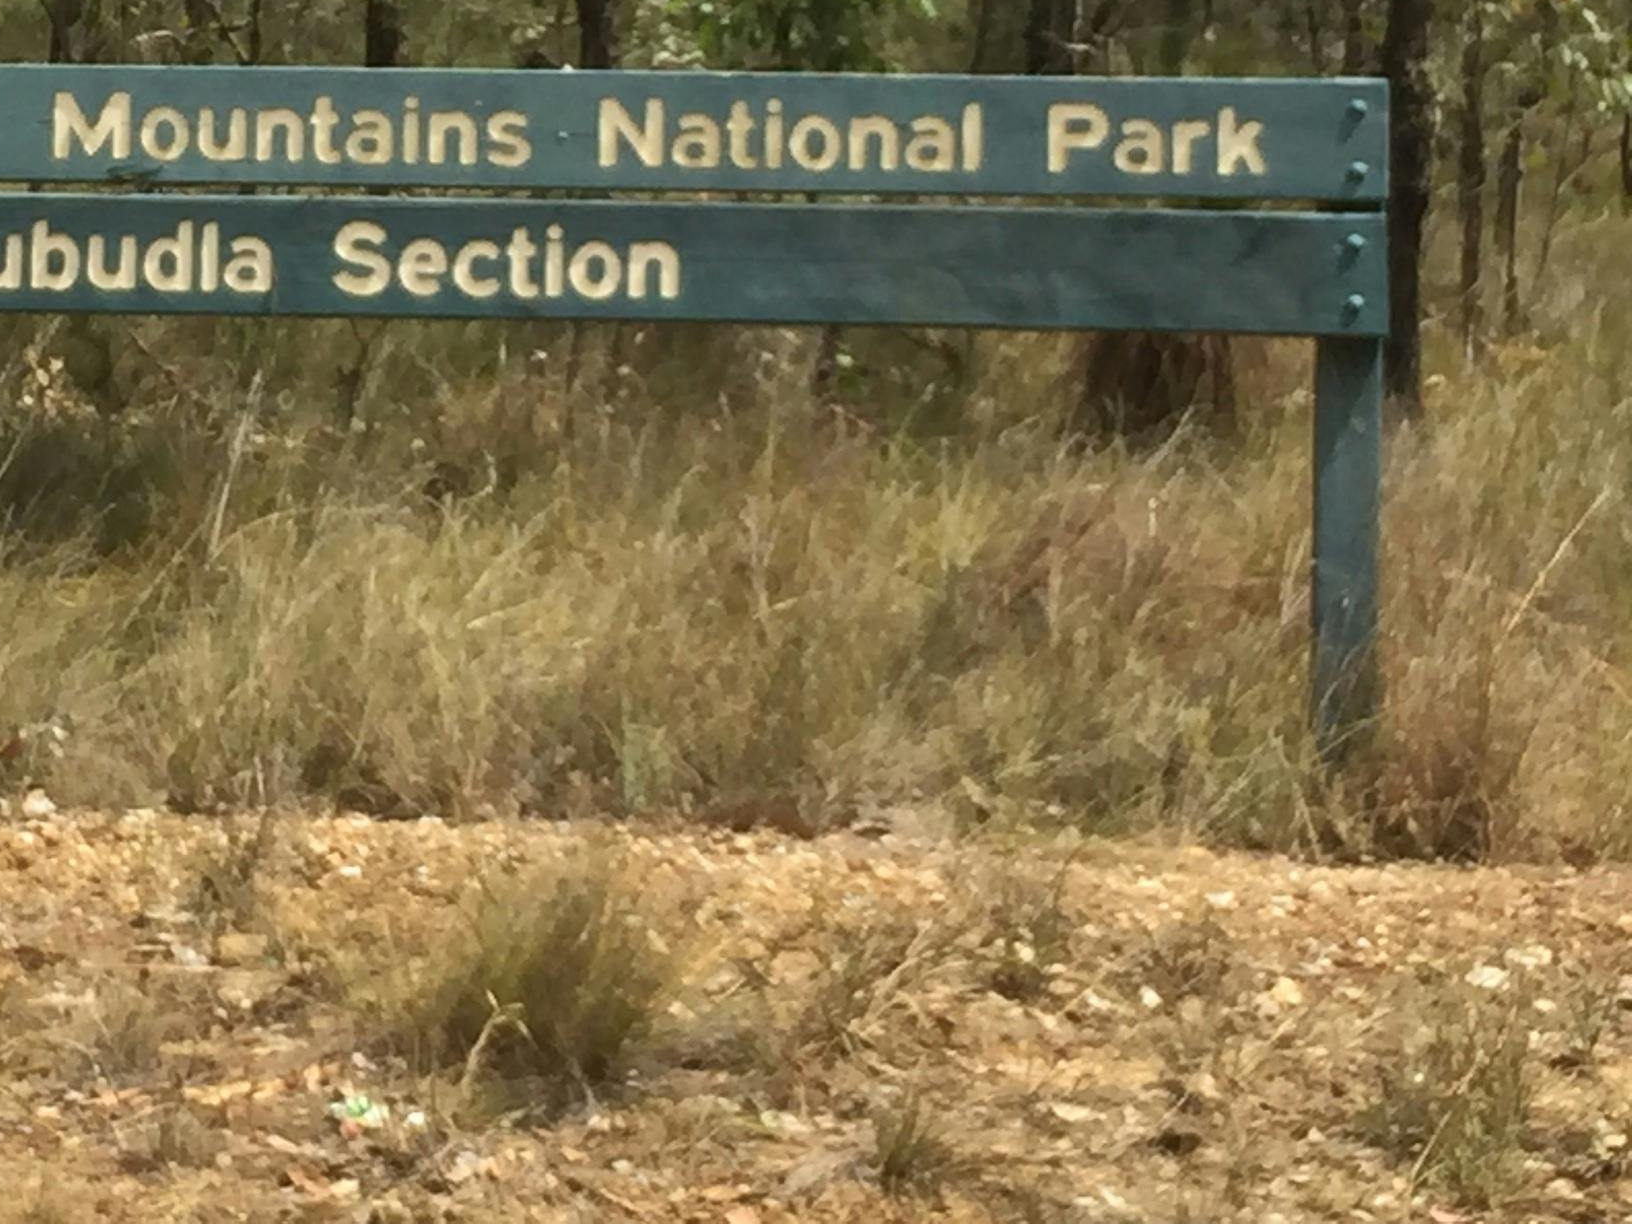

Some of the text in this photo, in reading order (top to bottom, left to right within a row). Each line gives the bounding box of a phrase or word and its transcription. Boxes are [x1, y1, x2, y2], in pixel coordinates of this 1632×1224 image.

[51, 91, 532, 169] Mountains
[597, 97, 983, 174] National
[1047, 102, 1267, 177] Park
[332, 221, 681, 302] Section
